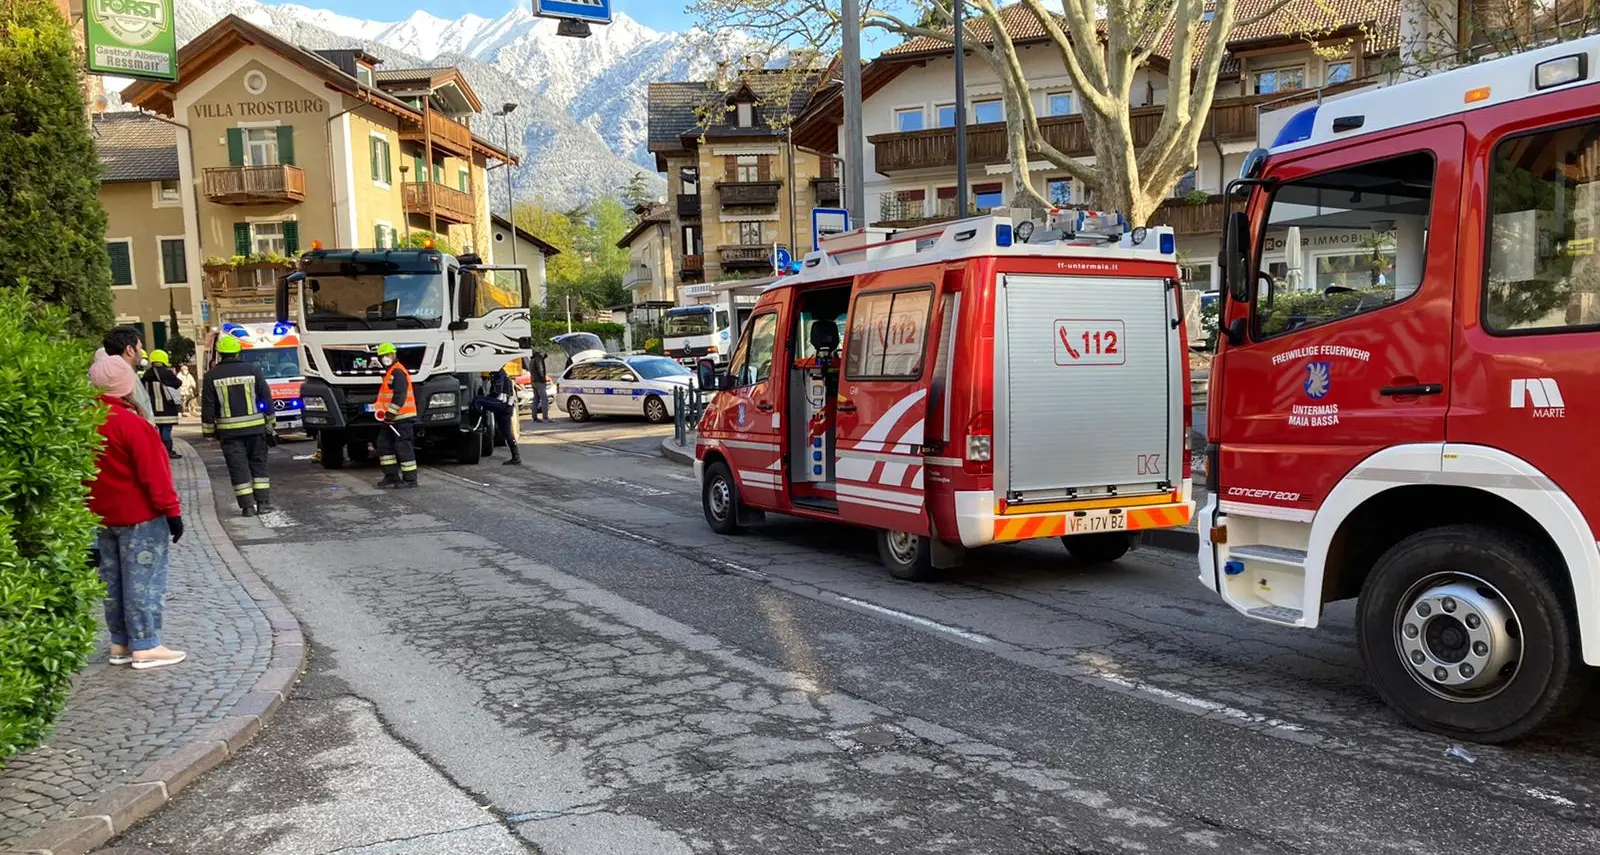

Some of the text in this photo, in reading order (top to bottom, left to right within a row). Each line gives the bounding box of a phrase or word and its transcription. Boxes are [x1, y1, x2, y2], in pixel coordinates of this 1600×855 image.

[96, 46, 169, 63] Gasthof Albergo
[194, 99, 323, 118] VILLA TROSTBURG
[1057, 261, 1118, 271] ff-untermais.it
[1081, 330, 1117, 354] 112
[353, 356, 384, 368] MA
[1272, 345, 1370, 366] FREIWILLIGE FEUERWEHR
[1292, 404, 1338, 416] UNTERMAIS
[1532, 408, 1565, 418] MARTE
[1288, 415, 1339, 427] MAIA BASSA
[1071, 518, 1083, 532] VF
[1111, 515, 1124, 529] BZ
